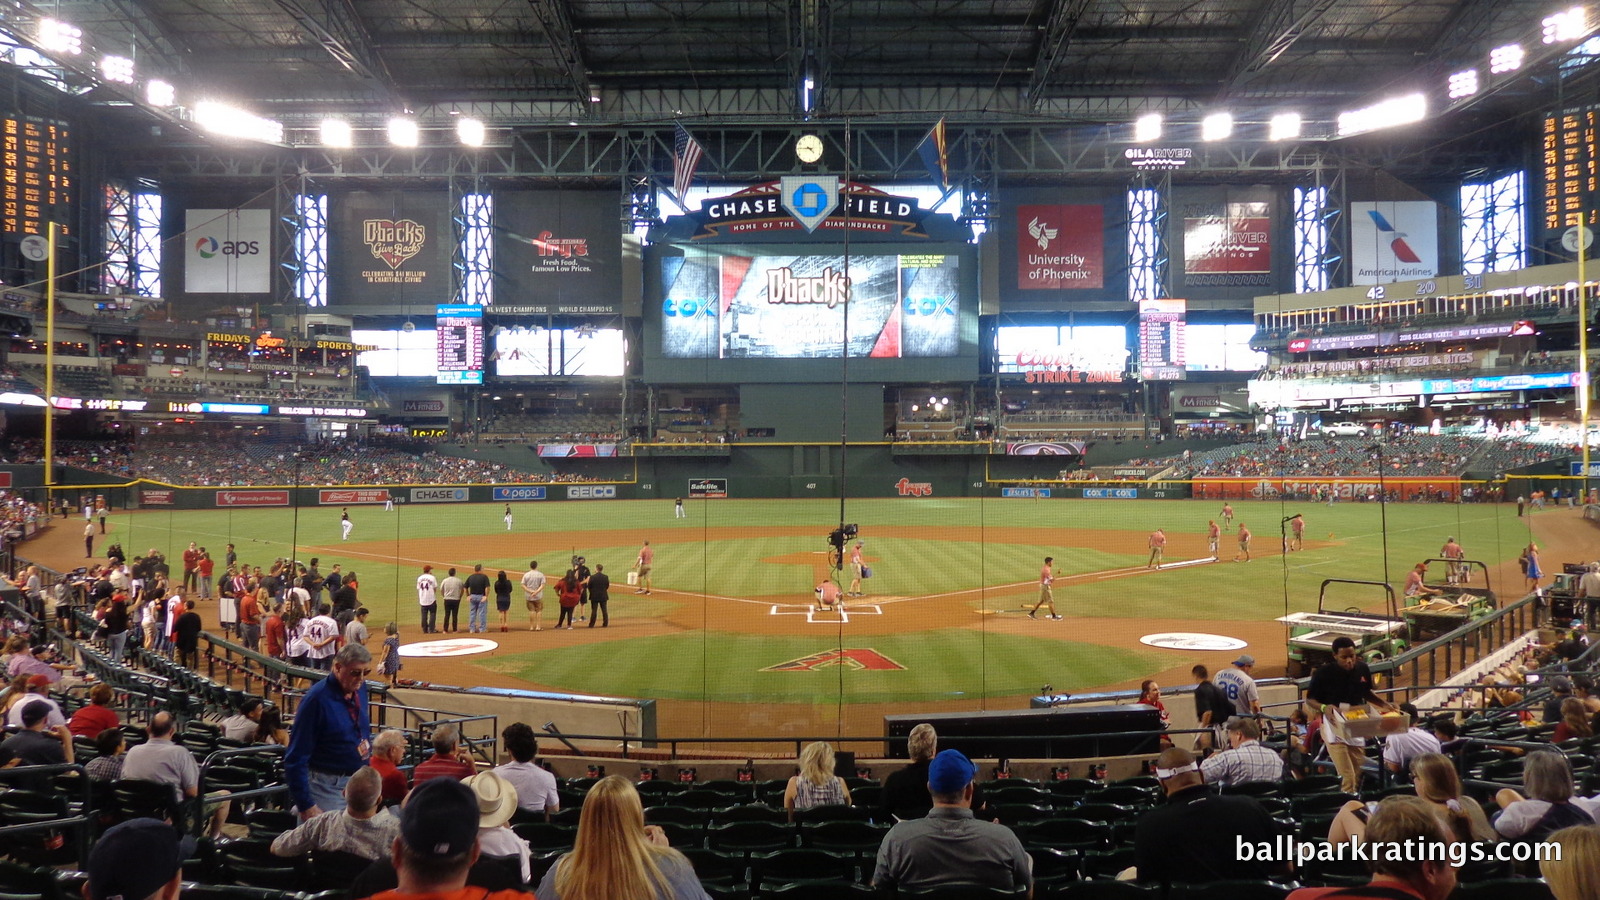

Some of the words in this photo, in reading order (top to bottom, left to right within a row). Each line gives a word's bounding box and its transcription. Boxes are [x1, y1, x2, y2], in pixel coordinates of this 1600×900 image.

[1125, 149, 1154, 158] GILA
[1154, 148, 1192, 158] RIVER
[709, 199, 776, 218] CHASE
[844, 199, 910, 216] FIELD
[364, 220, 424, 244] Dbacks
[1224, 232, 1267, 243] IVER
[222, 241, 259, 258] aps
[373, 242, 393, 256] Give
[394, 242, 420, 256] Back
[1028, 254, 1085, 267] University
[1028, 268, 1040, 279] of
[1043, 268, 1088, 279] Phoenix
[766, 267, 852, 309] Dbacks
[1416, 281, 1436, 294] 20
[1464, 275, 1482, 289] 51
[1366, 286, 1384, 299] 42
[664, 294, 718, 319] COX
[903, 292, 958, 319] COX
[447, 317, 472, 326] Dbacks
[207, 333, 251, 343] FRIDAY'S
[317, 341, 352, 350] SPORTS
[1404, 356, 1429, 366] BEER
[1432, 355, 1442, 364] &
[1445, 352, 1473, 363] BITES
[1298, 363, 1326, 373] DRAFT
[1329, 361, 1356, 371] ROOM
[1025, 370, 1081, 383] STRIKE
[1086, 370, 1122, 382] ZONE
[511, 488, 539, 499] pepsi
[569, 487, 614, 497] GEICO
[895, 478, 932, 496] fry's
[417, 491, 452, 499] CHASE
[311, 627, 322, 638] 44
